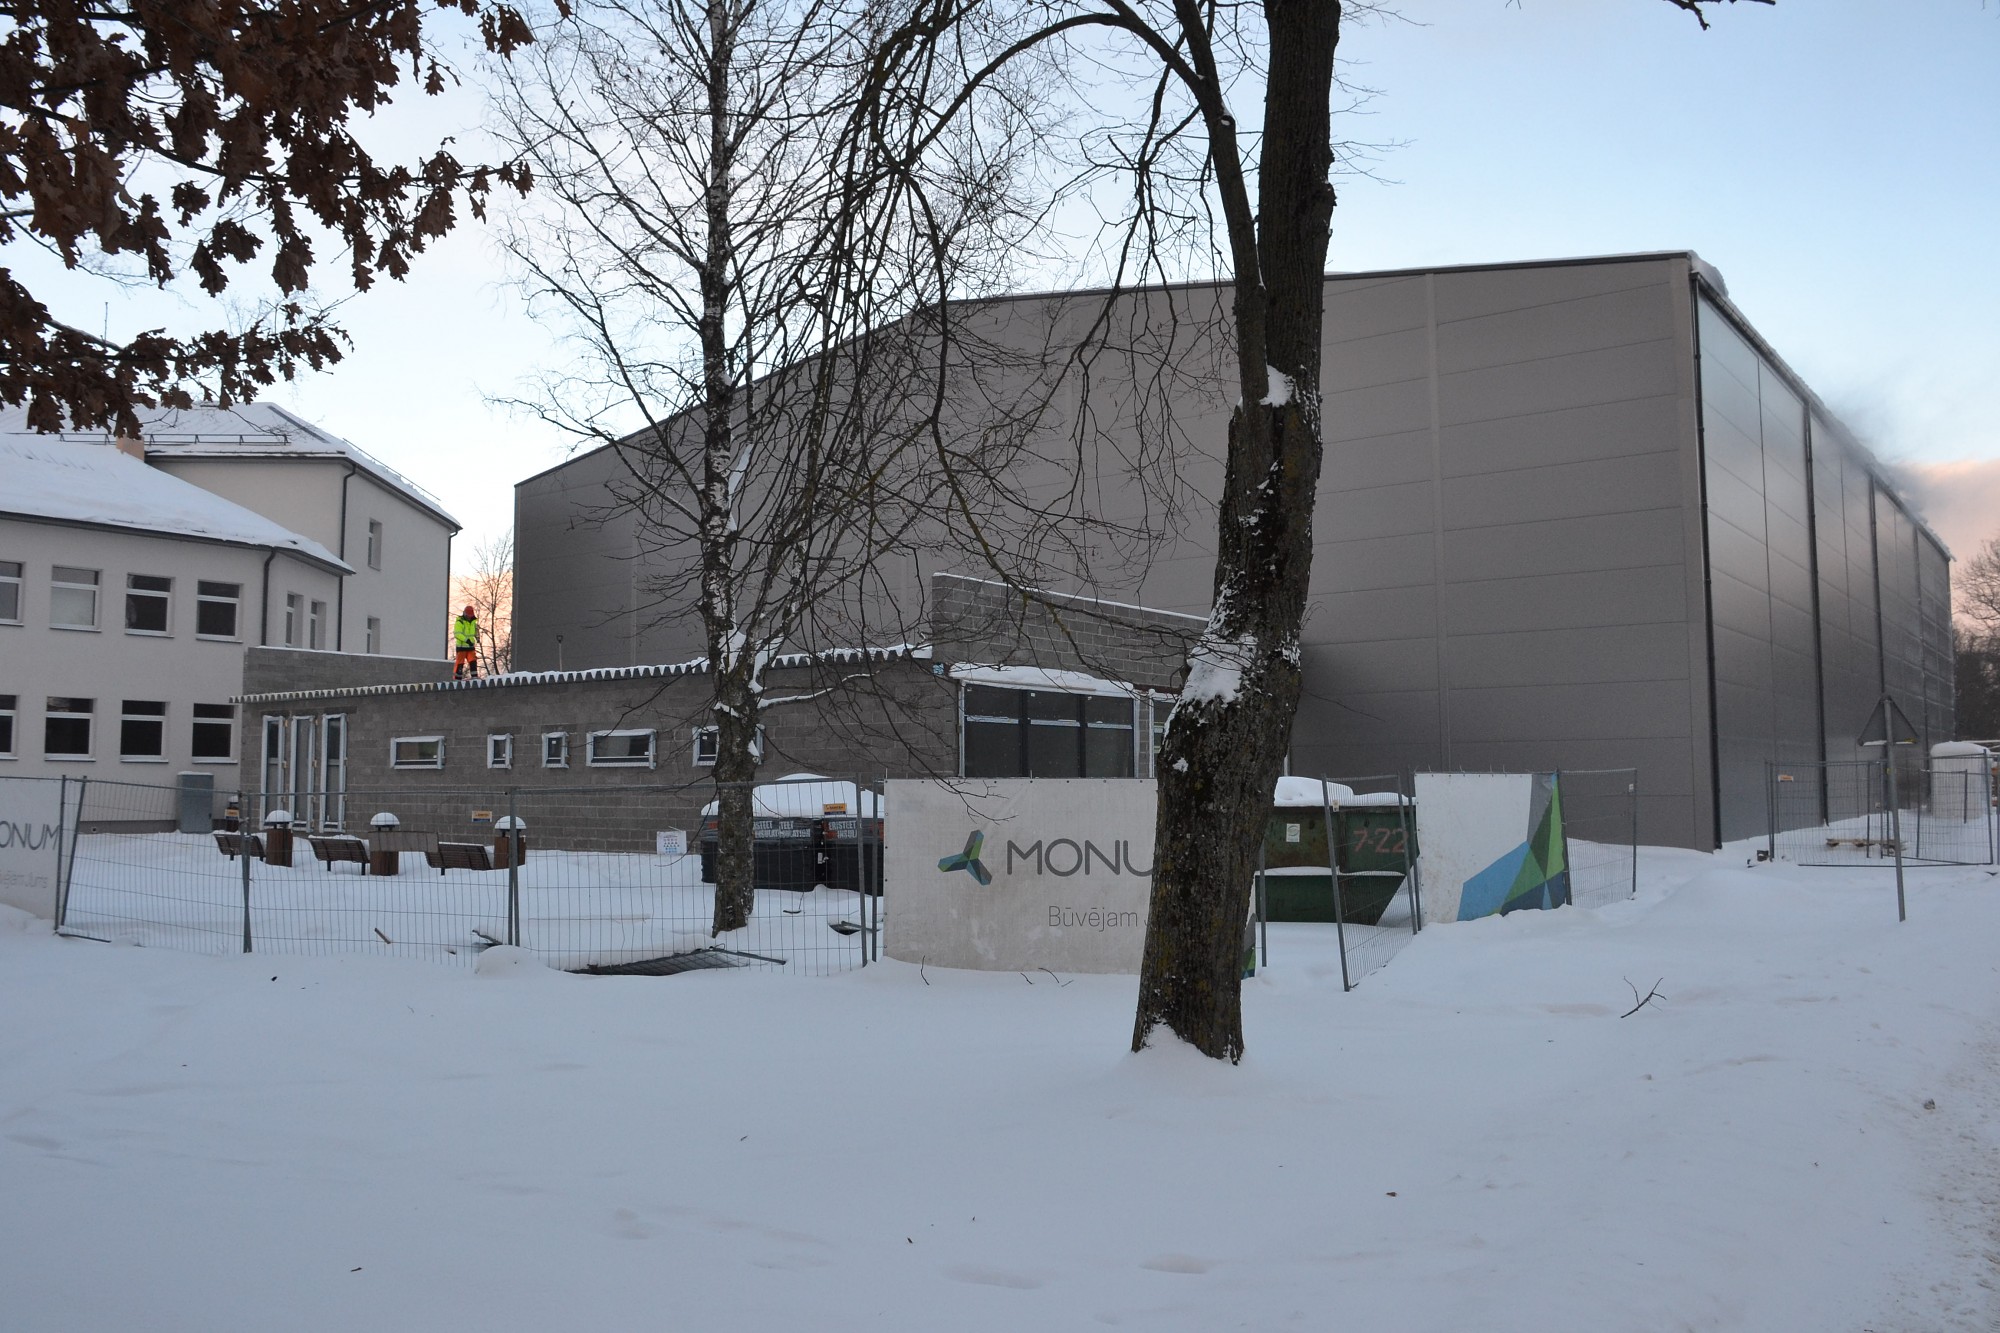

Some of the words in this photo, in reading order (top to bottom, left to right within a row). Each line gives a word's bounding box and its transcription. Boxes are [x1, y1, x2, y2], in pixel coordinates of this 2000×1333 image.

[0, 820, 61, 850] ONUM
[1007, 838, 1154, 877] MONU
[1048, 905, 1138, 932] Būvējam
